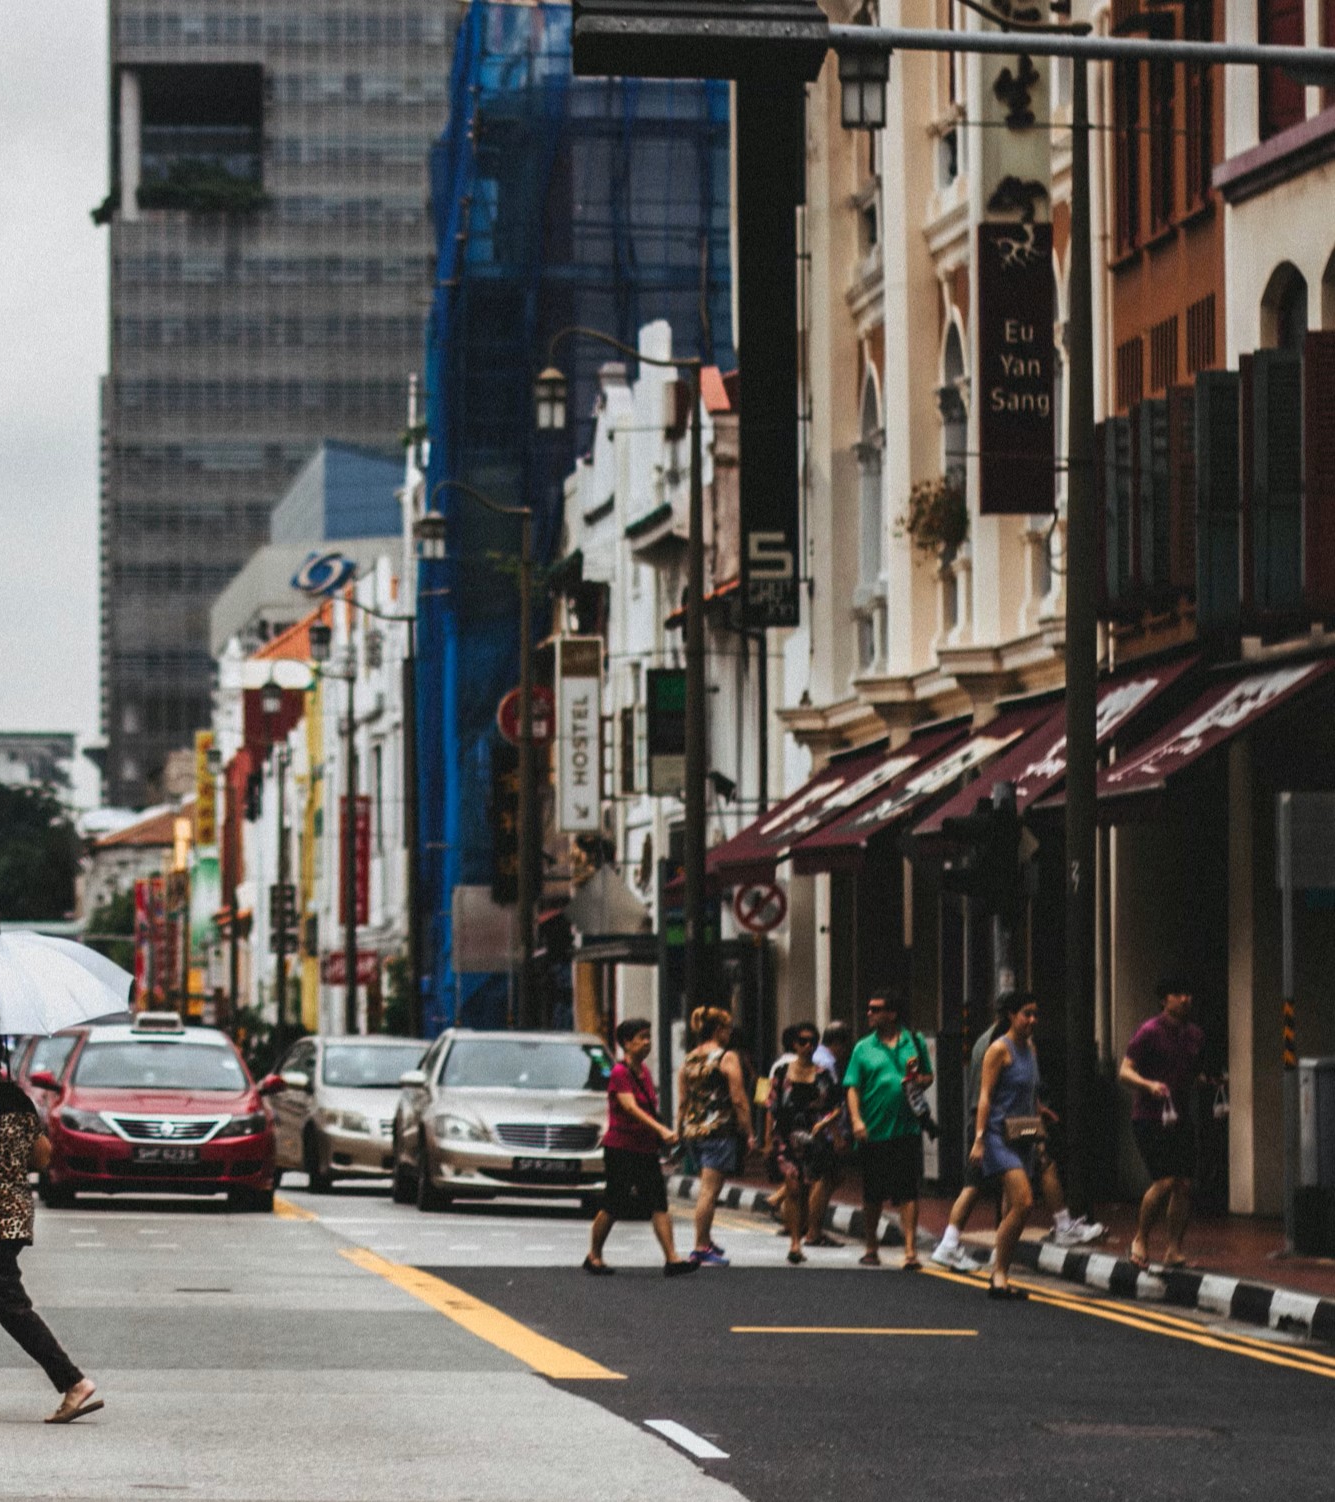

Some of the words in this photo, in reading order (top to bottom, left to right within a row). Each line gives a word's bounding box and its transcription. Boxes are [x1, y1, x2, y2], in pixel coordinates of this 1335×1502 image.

[1005, 320, 1033, 343] Eu
[1000, 353, 1041, 377] Yan
[991, 387, 1050, 417] Sang
[748, 531, 793, 579] 5
[572, 696, 589, 786] HOSTEL
